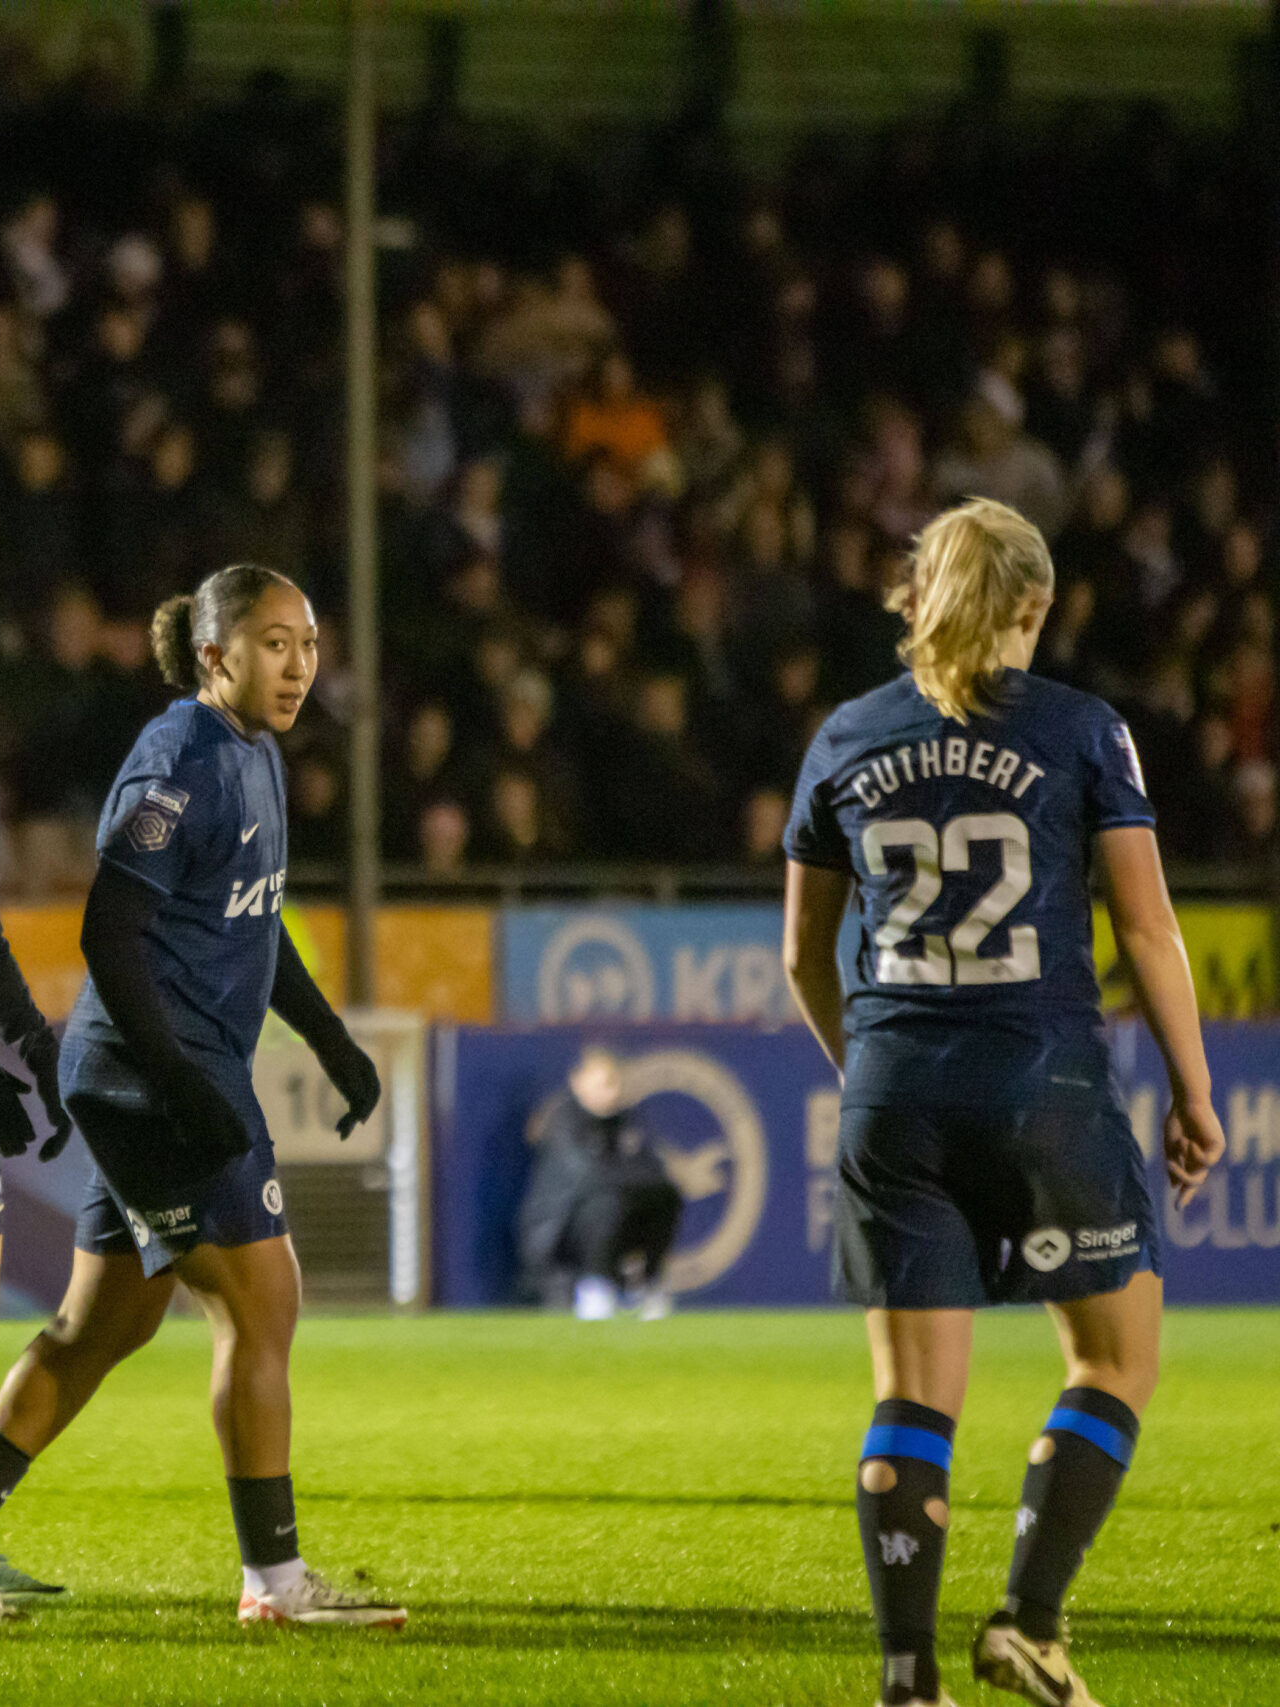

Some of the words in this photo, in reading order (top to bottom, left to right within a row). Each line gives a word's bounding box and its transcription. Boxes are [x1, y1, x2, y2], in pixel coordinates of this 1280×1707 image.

[852, 736, 1045, 809] CUTHBERT
[862, 811, 1042, 985] 22
[1077, 1223, 1137, 1249] Singer
